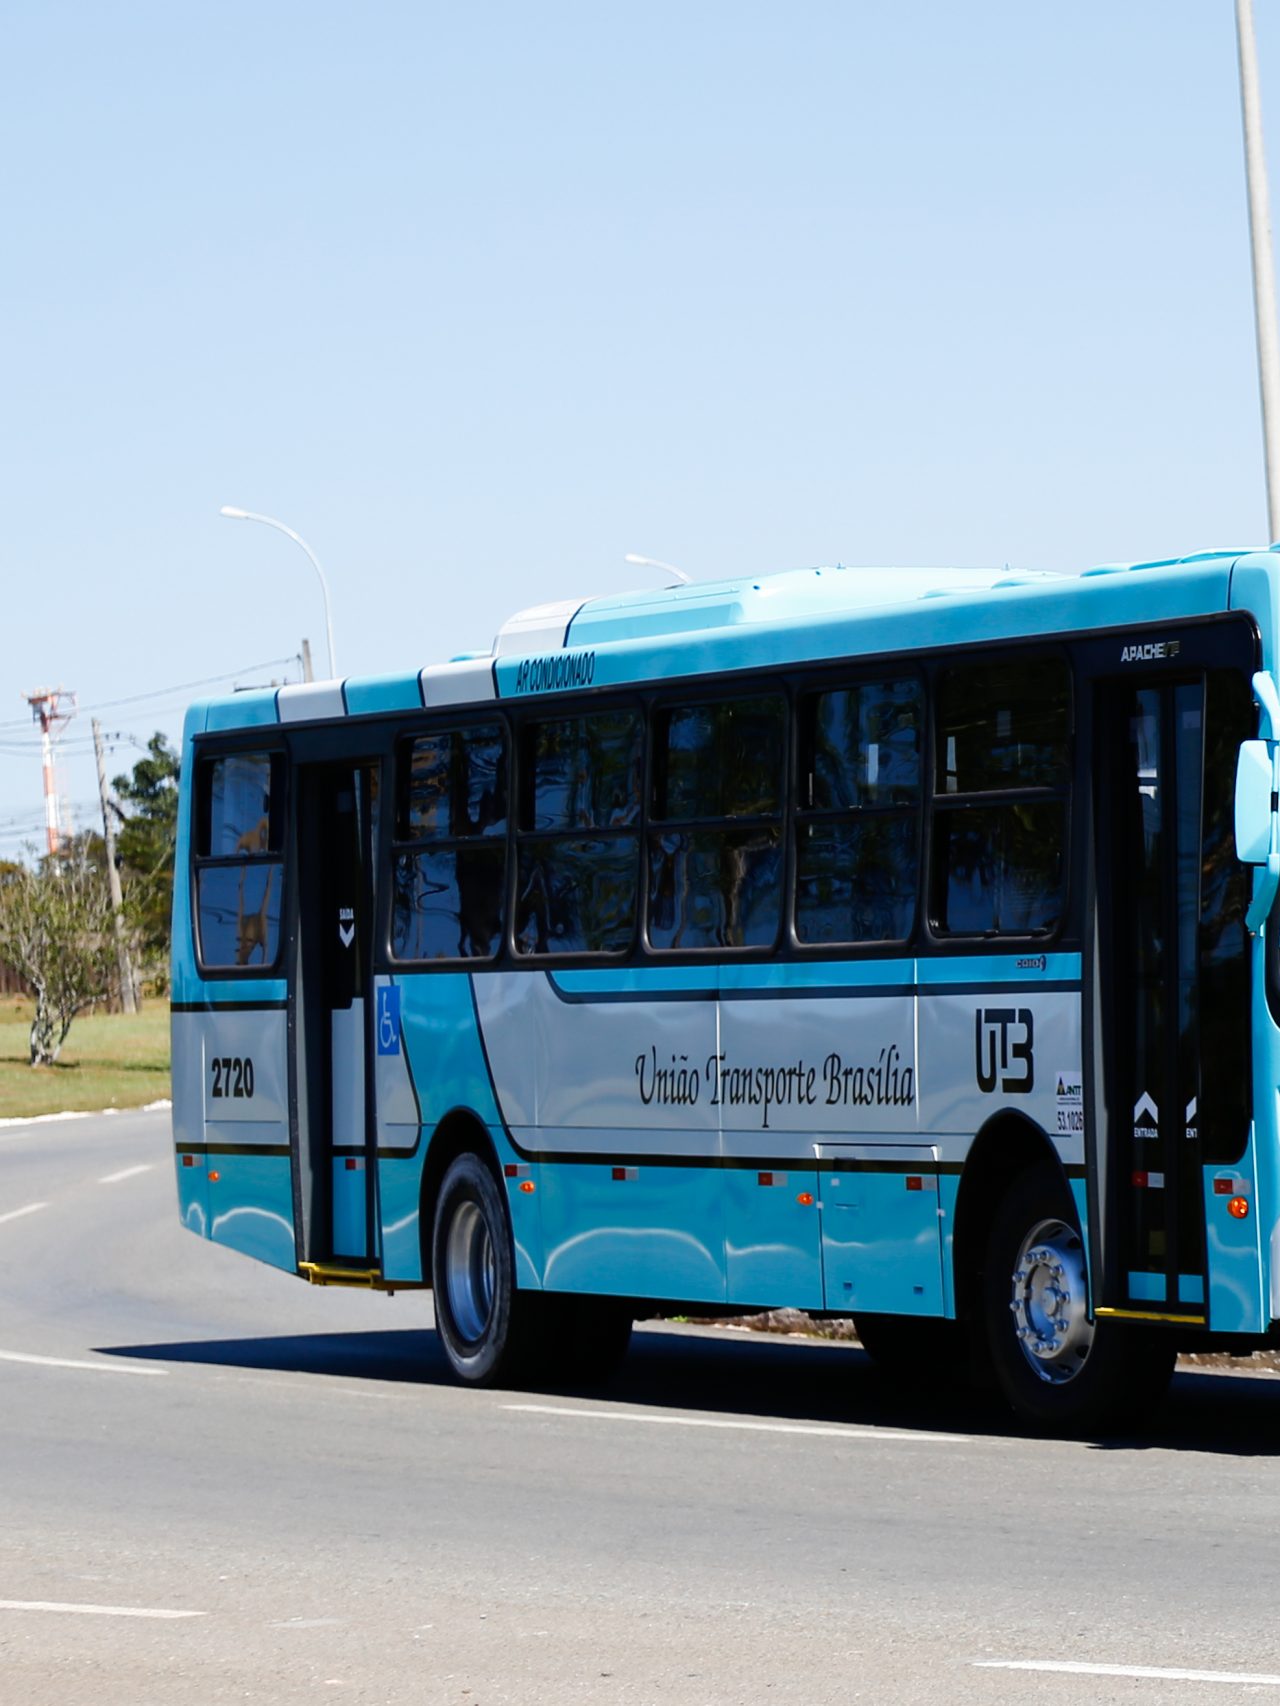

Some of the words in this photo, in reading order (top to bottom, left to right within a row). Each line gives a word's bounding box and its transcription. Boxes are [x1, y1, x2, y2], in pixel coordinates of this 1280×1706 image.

[515, 659, 530, 694] AR
[530, 651, 596, 691] CONDICIONADO
[1120, 643, 1166, 662] APACHE
[975, 1008, 1034, 1094] UTB
[211, 1057, 254, 1098] 2720
[634, 1045, 700, 1105] União
[705, 1051, 817, 1128] Transporte
[823, 1044, 915, 1106] Brasília
[1133, 1127, 1159, 1138] ENTRADA
